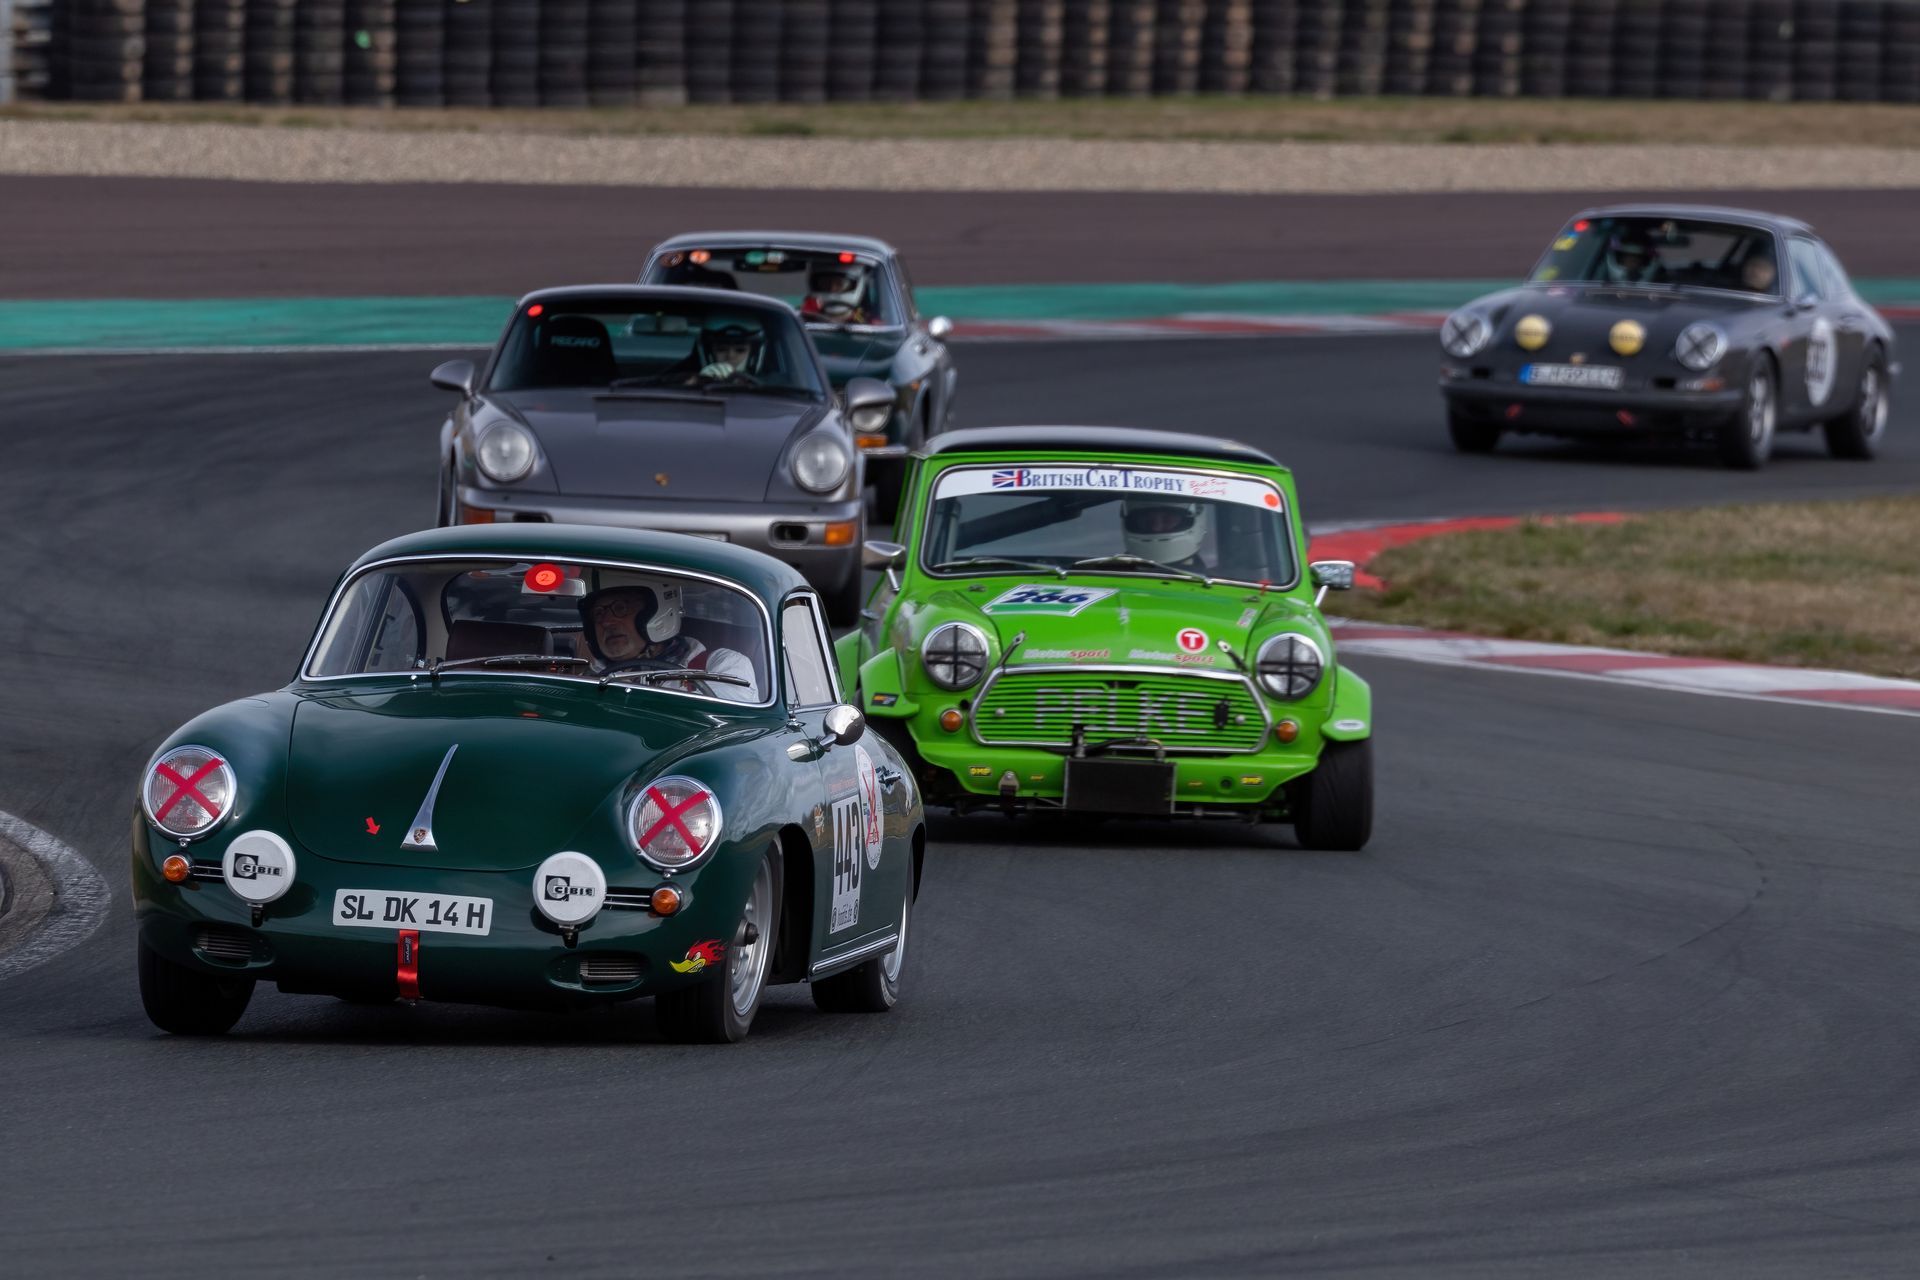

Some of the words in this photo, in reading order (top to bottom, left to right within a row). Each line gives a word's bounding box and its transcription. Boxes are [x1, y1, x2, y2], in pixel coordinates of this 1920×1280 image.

[1000, 589, 1092, 604] 266
[1185, 633, 1200, 648] T
[835, 801, 861, 895] 443
[340, 895, 374, 921] SL
[383, 896, 420, 924] DK
[426, 900, 459, 927] 14
[466, 902, 486, 929] H
